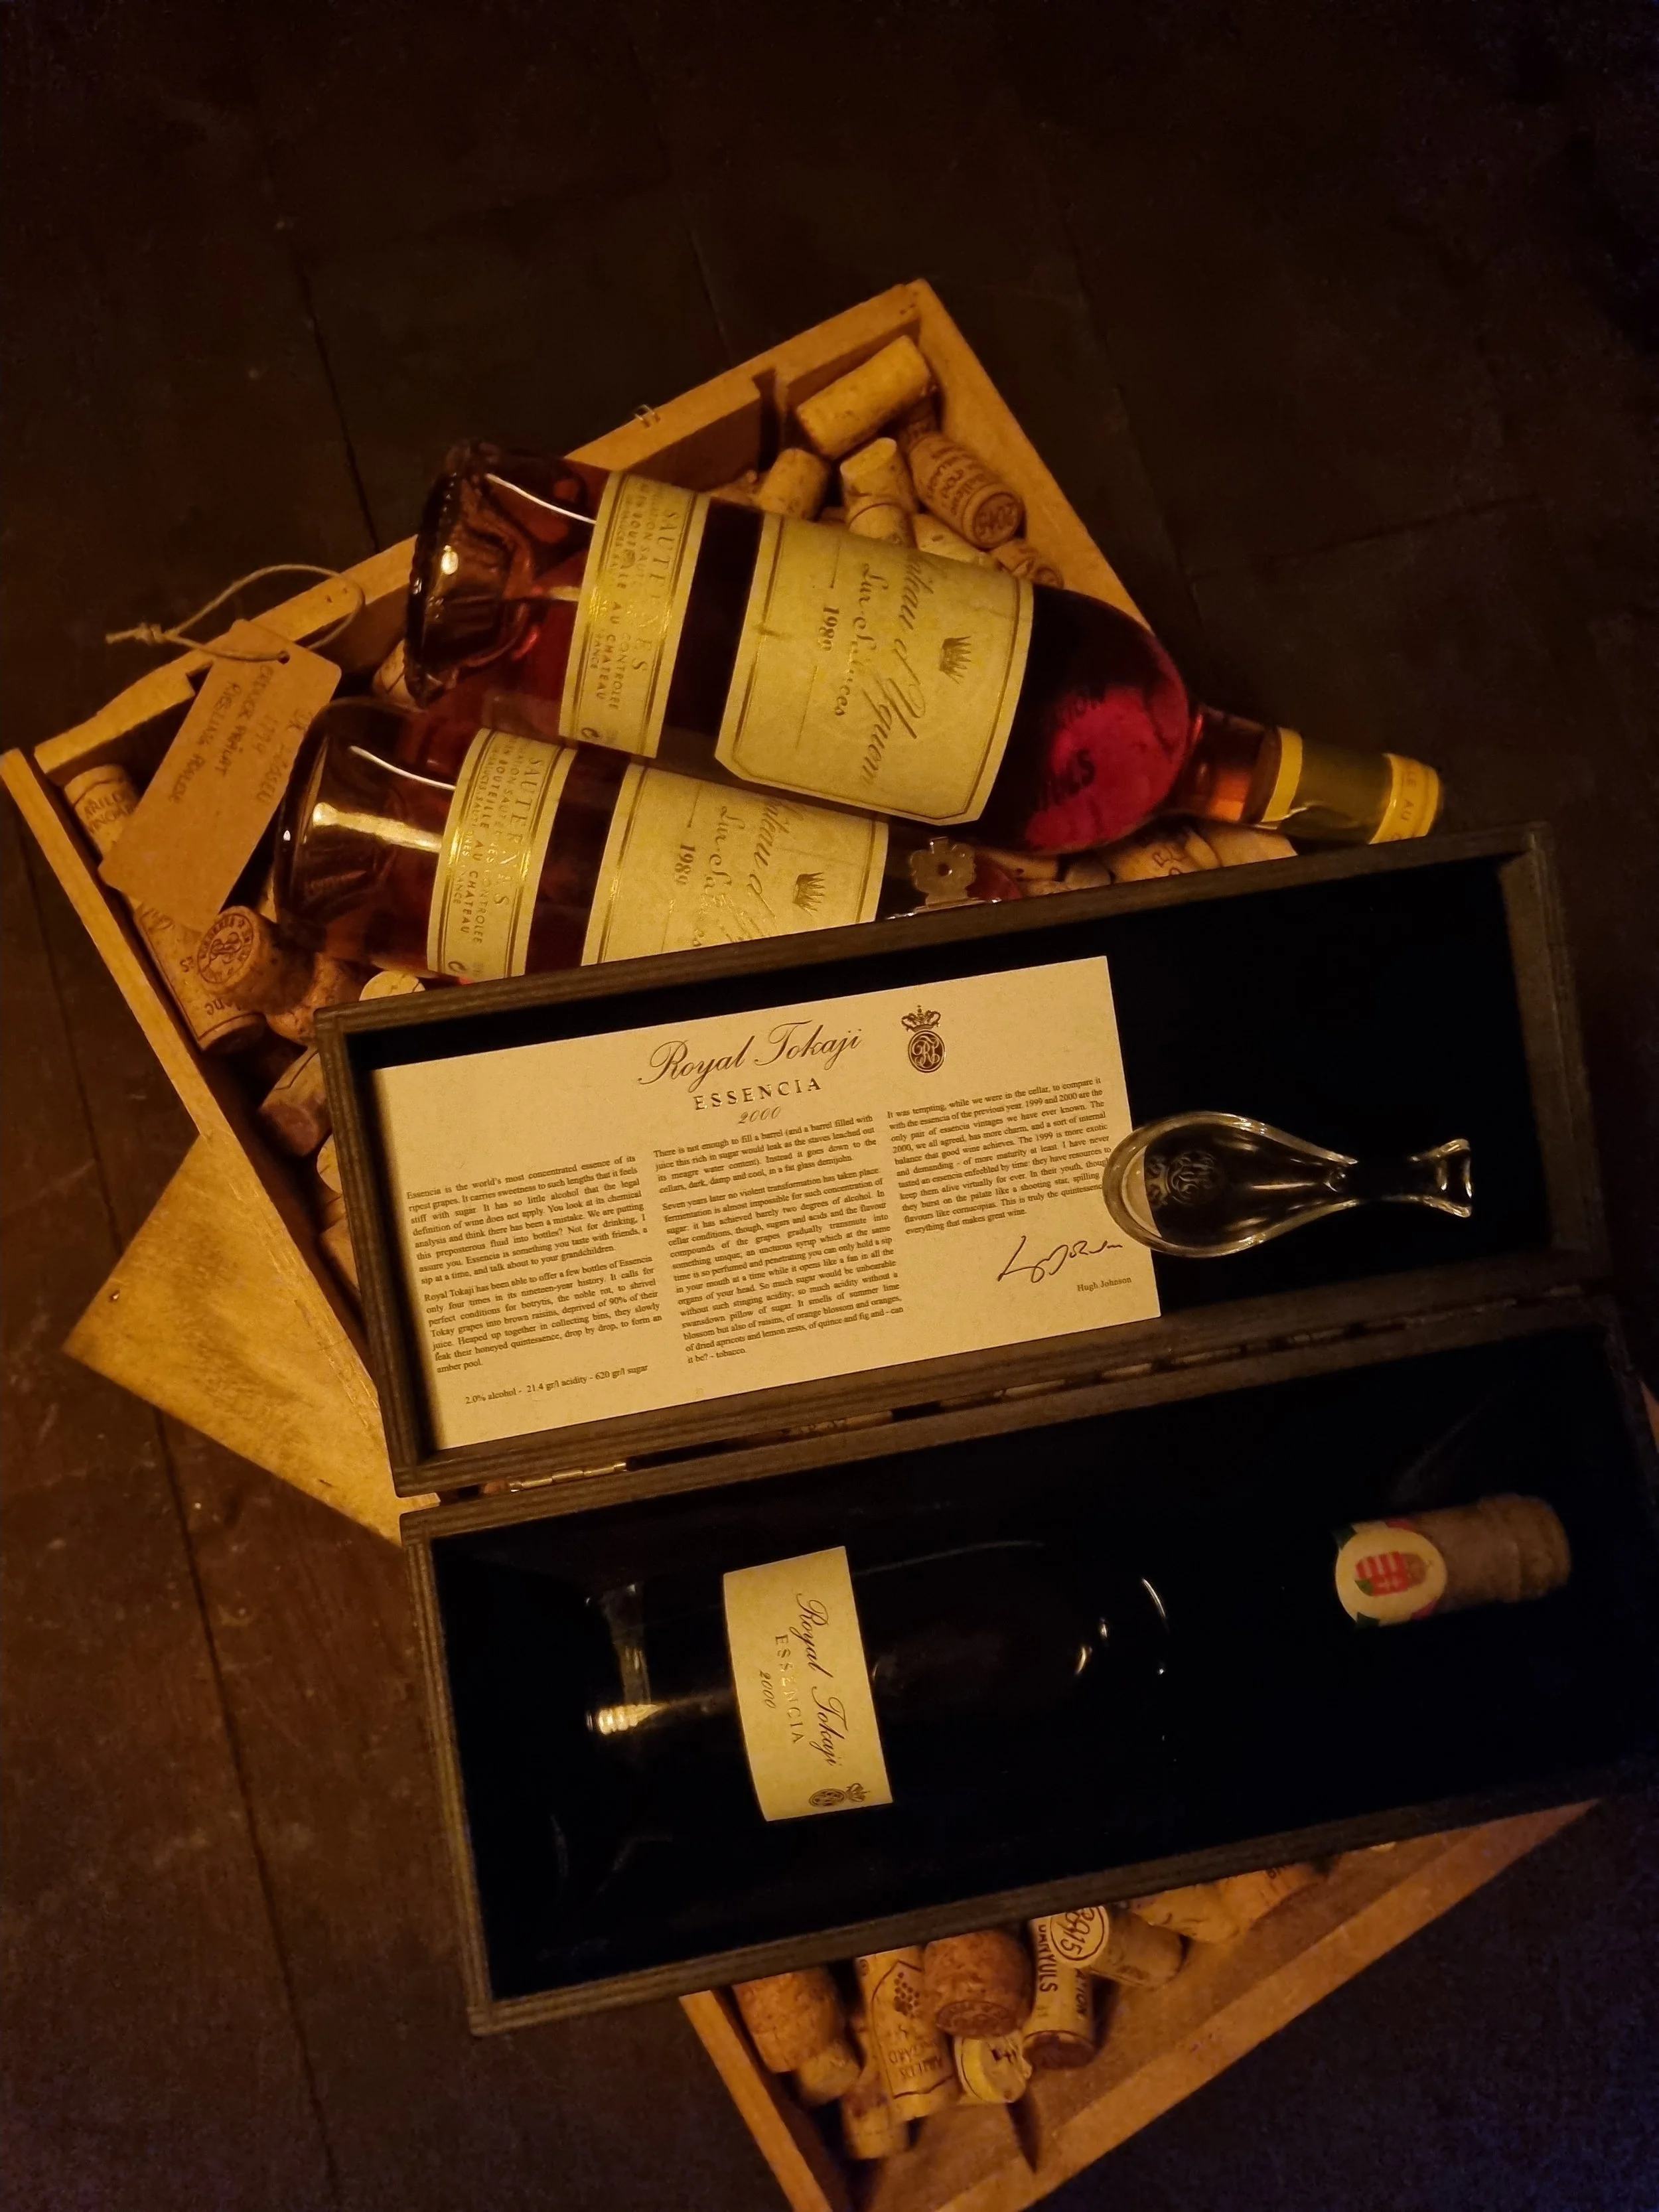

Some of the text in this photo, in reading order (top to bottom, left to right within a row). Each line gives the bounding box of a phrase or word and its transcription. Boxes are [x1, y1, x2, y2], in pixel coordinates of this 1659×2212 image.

[610, 601, 623, 625] AU
[595, 634, 617, 700] CHATEAU
[479, 759, 507, 830] BOUTEILLE
[1400, 800, 1415, 822] AU
[472, 840, 485, 862] AU
[460, 871, 478, 934] CHATEAU
[637, 1035, 755, 1094] Royal
[754, 1019, 863, 1071] Tokaji
[693, 1076, 822, 1110] ESSENCIA
[886, 1110, 894, 1119] It
[947, 1098, 970, 1108] while
[983, 1094, 1003, 1102] were
[1004, 1091, 1013, 1100] in
[1014, 1089, 1027, 1098] the
[1061, 1079, 1094, 1090] compare
[889, 1121, 906, 1130] with
[906, 1119, 919, 1128] the
[919, 1115, 951, 1126] essencia
[950, 1111, 960, 1120] of
[960, 1110, 973, 1118] the
[972, 1105, 1005, 1118] previous
[1025, 1097, 1044, 1108] 1999
[1044, 1094, 1058, 1104] and
[1058, 1092, 1078, 1102] 2000
[652, 1149, 676, 1158] There
[685, 1143, 699, 1153] not
[700, 1138, 729, 1150] enough
[741, 1134, 753, 1143] fill
[760, 1128, 784, 1140] barrel
[809, 1120, 833, 1132] barrel
[833, 1116, 855, 1128] filled
[855, 1114, 873, 1124] with
[737, 1105, 782, 1125] 2000
[890, 1133, 908, 1142] only
[910, 1131, 925, 1141] pair
[928, 1126, 938, 1136] of
[938, 1123, 970, 1134] essencia
[972, 1118, 1004, 1128] vintages
[1020, 1112, 1039, 1120] have
[1041, 1108, 1057, 1117] ever
[1089, 1100, 1105, 1108] The
[655, 1161, 675, 1173] juice
[675, 1158, 691, 1167] this
[690, 1154, 708, 1164] rich
[717, 1150, 739, 1160] sugar
[739, 1143, 765, 1155] would
[766, 1141, 783, 1151] leak
[793, 1138, 806, 1147] the
[807, 1135, 831, 1144] staves
[831, 1128, 861, 1140] leached
[861, 1126, 875, 1135] out
[670, 1169, 699, 1180] meagre
[702, 1165, 725, 1174] water
[764, 1151, 793, 1163] Instead
[806, 1148, 824, 1158] goes
[828, 1143, 849, 1153] down
[863, 1138, 877, 1147] the
[405, 1188, 441, 1200] Essencia
[455, 1183, 469, 1191] the
[470, 1177, 502, 1189] world's
[504, 1173, 525, 1184] most
[528, 1163, 578, 1180] concentrated
[580, 1159, 611, 1171] essence
[613, 1155, 623, 1165] of
[408, 1201, 431, 1213] ripest
[461, 1195, 469, 1203] It
[469, 1191, 496, 1201] carries
[496, 1185, 537, 1197] sweetness
[546, 1178, 566, 1189] such
[565, 1173, 595, 1185] lengths
[595, 1171, 611, 1180] that
[618, 1166, 638, 1176] feels
[410, 1213, 427, 1224] stiff
[431, 1210, 450, 1220] with
[482, 1203, 490, 1212] It
[494, 1201, 509, 1210] has
[527, 1194, 546, 1205] little
[550, 1187, 579, 1201] alcohol
[583, 1186, 599, 1195] that
[603, 1183, 616, 1191] the
[620, 1177, 640, 1189] legal
[1076, 1276, 1132, 1292] Hugh Johnson
[465, 1394, 486, 1404] 2.0%
[487, 1387, 517, 1400] alcohol
[526, 1382, 544, 1393] 21.4
[545, 1379, 560, 1392] gr/l
[560, 1375, 587, 1386] acidity
[594, 1370, 611, 1380] 620
[611, 1367, 626, 1379] gr/l
[626, 1364, 648, 1374] sugar
[789, 1593, 833, 1678] Royal
[758, 1670, 776, 1708] 2000
[774, 1634, 805, 1743] ESSENCIA
[809, 1686, 848, 1767] Tokaji
